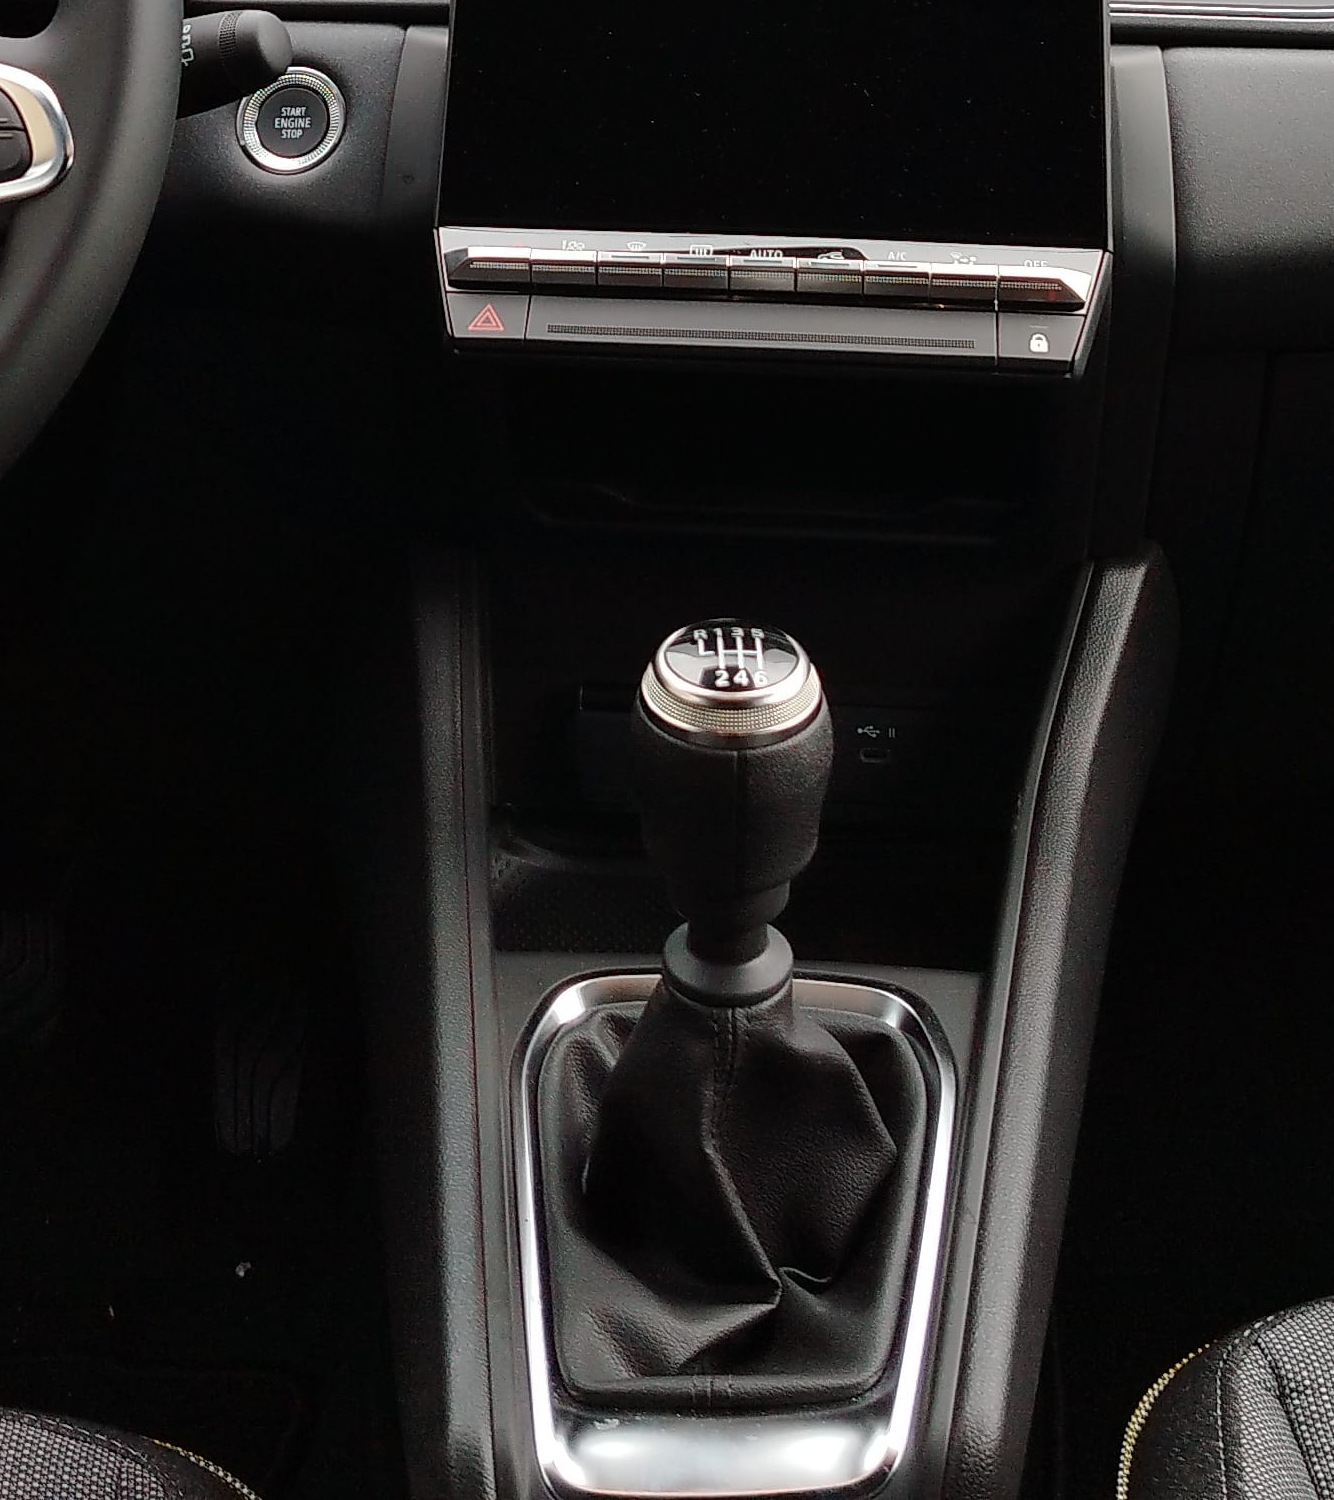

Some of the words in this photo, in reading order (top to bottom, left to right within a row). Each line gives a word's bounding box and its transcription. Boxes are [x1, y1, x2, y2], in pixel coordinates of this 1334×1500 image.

[281, 107, 306, 116] START
[274, 117, 311, 128] ENGINE
[281, 129, 303, 139] STOP
[750, 249, 784, 259] AUTO
[887, 251, 908, 261] A/C
[693, 628, 708, 641] R
[713, 627, 723, 637] 1
[731, 626, 745, 638] 3
[751, 627, 765, 639] 5
[714, 669, 730, 688] 2
[733, 669, 749, 687] 4
[754, 670, 768, 687] 6
